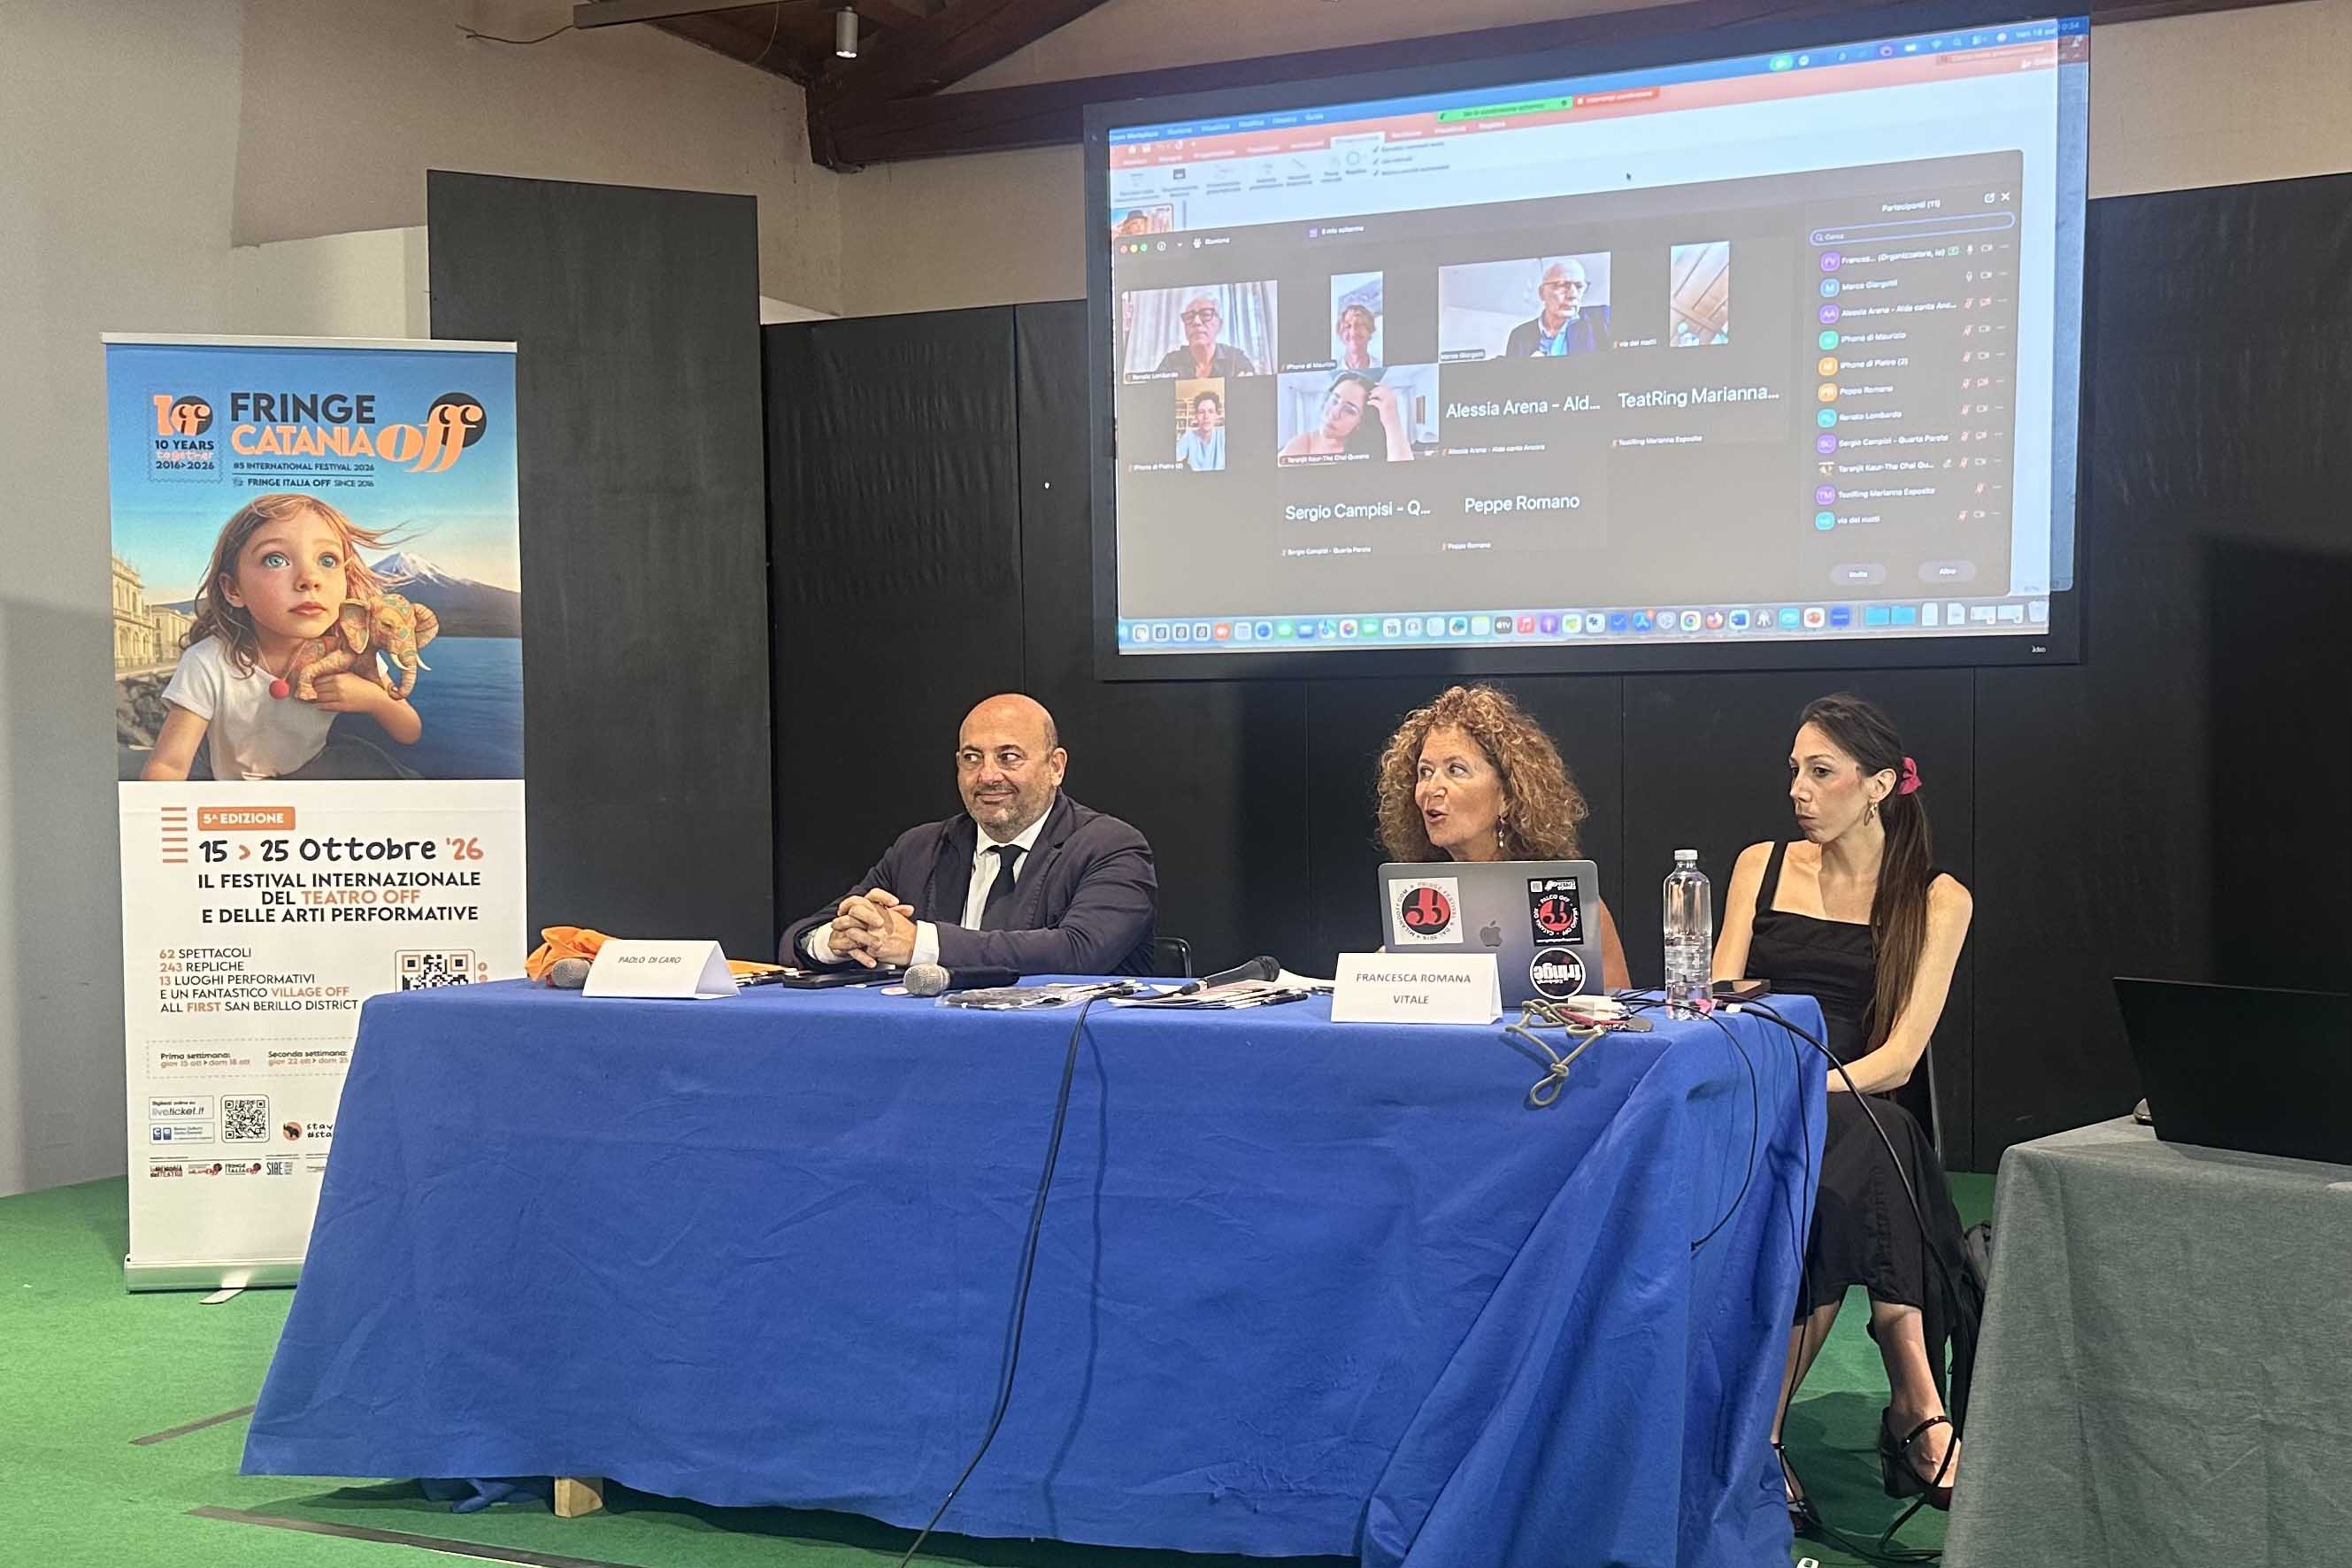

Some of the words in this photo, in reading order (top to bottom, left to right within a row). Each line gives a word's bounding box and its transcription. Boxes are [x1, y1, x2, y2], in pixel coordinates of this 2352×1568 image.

[1618, 388, 1687, 409] TeatRing
[1691, 385, 1779, 405] Marianna...
[231, 393, 375, 424] FRINGE
[1445, 400, 1500, 419] Alessia
[1503, 399, 1548, 416] Arena
[1563, 395, 1601, 412] Ald...
[155, 440, 168, 450] 10
[169, 440, 214, 450] YEARS
[232, 424, 376, 457] CATANIA
[246, 462, 313, 471] INTERNATIONAL
[314, 463, 351, 472] FESTIVAL
[247, 478, 281, 487] FRINGE
[312, 479, 331, 488] OFF
[1286, 503, 1332, 521] Sergio
[1334, 501, 1393, 519] Campisi
[1407, 499, 1431, 516] Q...
[1464, 496, 1512, 514] Peppe
[1516, 494, 1580, 511] Romano
[219, 812, 284, 825] EDIZIONE
[198, 840, 228, 863] 15
[260, 839, 289, 862] 25
[299, 837, 437, 862] Ottobre
[198, 873, 215, 889] IL
[220, 873, 306, 888] FESTIVAL
[312, 872, 481, 888] INTERNAZIONALE
[261, 891, 296, 905] DEL
[301, 890, 378, 905] TEATRO
[383, 889, 421, 904] OFF
[202, 910, 213, 924] E
[219, 909, 276, 924] DELLE
[281, 908, 326, 923] ARTI
[332, 906, 479, 922] PERFORMATIVE
[159, 949, 175, 959] 62
[178, 948, 252, 959] SPETTACOLI
[159, 962, 183, 972] 243
[186, 961, 244, 972] REPLICHE
[1533, 962, 1581, 981] fringe
[159, 975, 172, 986] 13
[174, 974, 224, 986] LUOGHI
[227, 973, 315, 985] PERFORMATIVI
[1356, 972, 1418, 982] FRANCESCA
[1420, 973, 1472, 983] ROMANA
[160, 988, 167, 999] E
[171, 988, 188, 999] UN
[192, 987, 268, 999] FANTASTICO
[271, 986, 323, 998] VILLAGE
[325, 986, 350, 997] OFF
[1393, 995, 1430, 1004] VITALE
[160, 1003, 183, 1013] ALL
[187, 1001, 221, 1012] FIRST
[224, 1000, 250, 1011] SAN
[253, 999, 302, 1011] BERILLO
[305, 998, 358, 1011] DISTRICT
